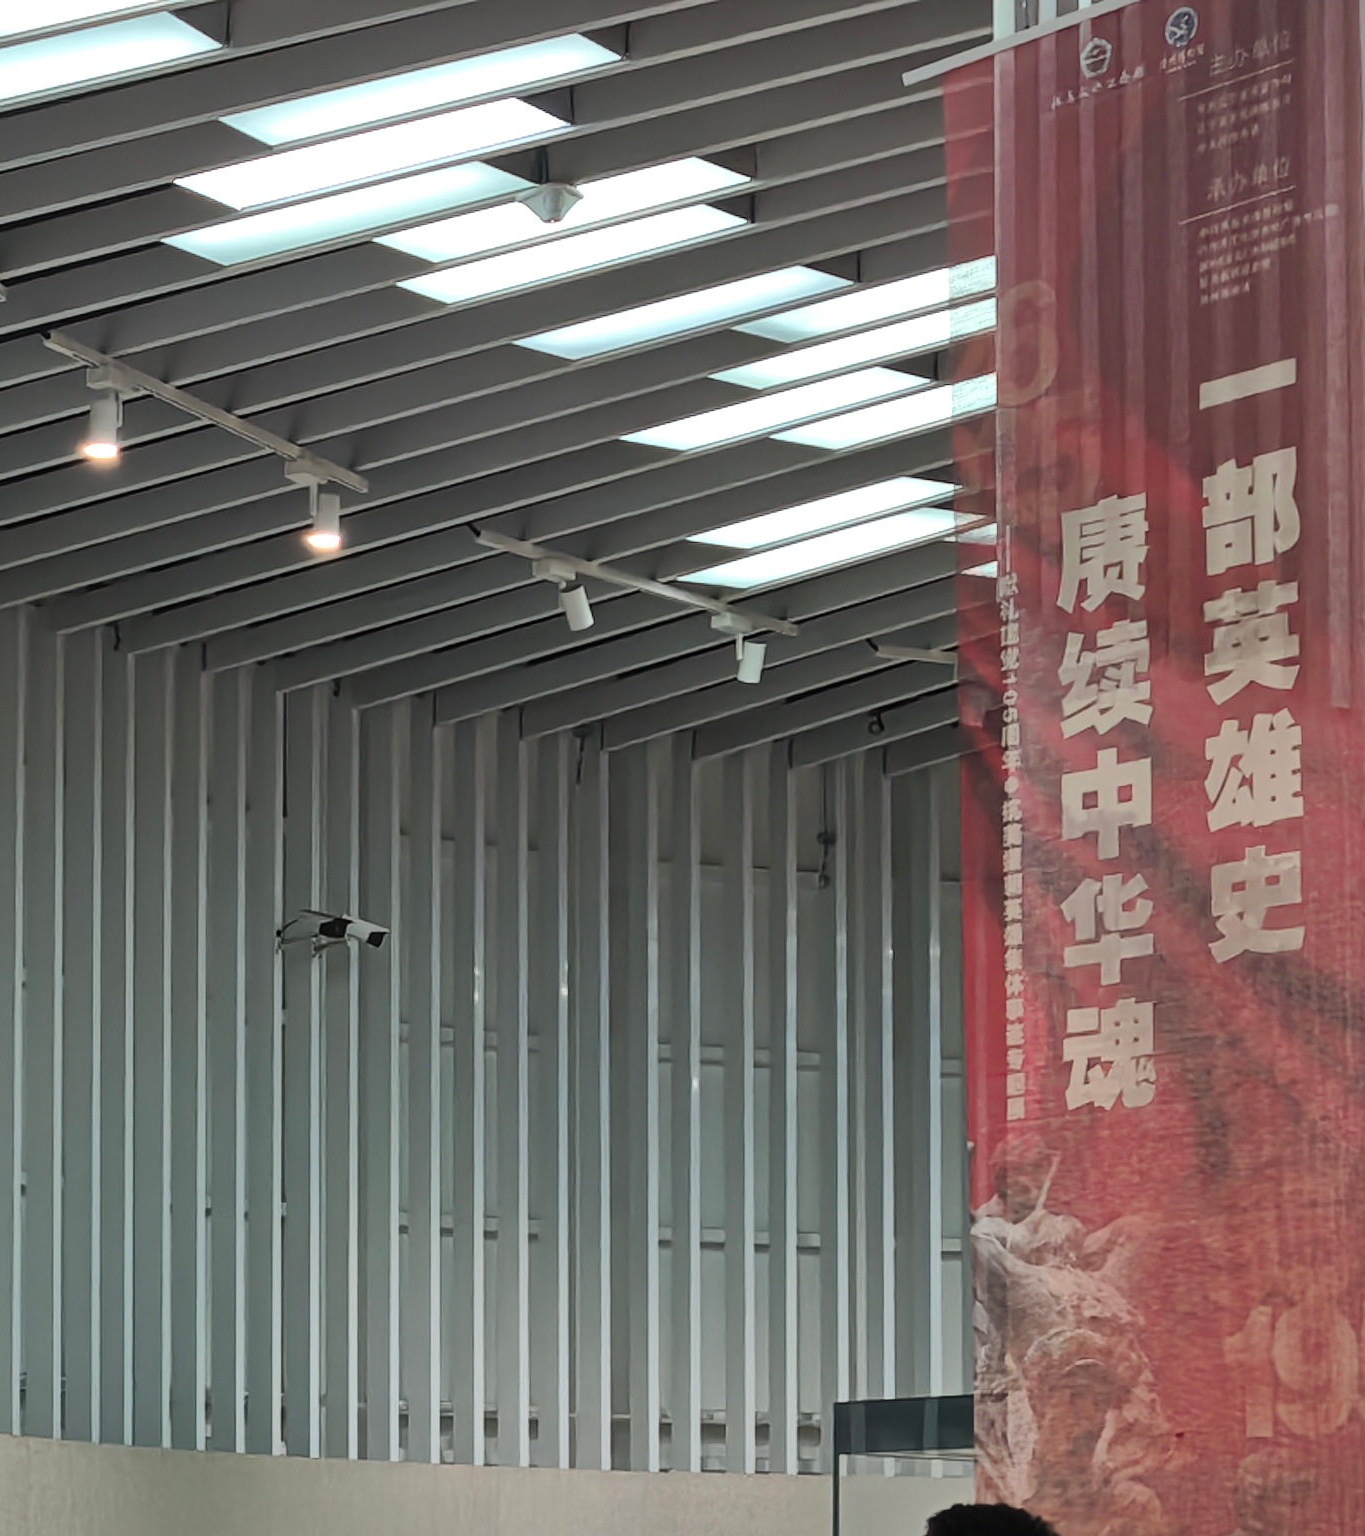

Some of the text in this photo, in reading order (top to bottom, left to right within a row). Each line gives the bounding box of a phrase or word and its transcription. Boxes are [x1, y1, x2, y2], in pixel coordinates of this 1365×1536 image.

[1055, 491, 1157, 1112] 赓续中华魂
[1197, 356, 1305, 964] 一部英雄史
